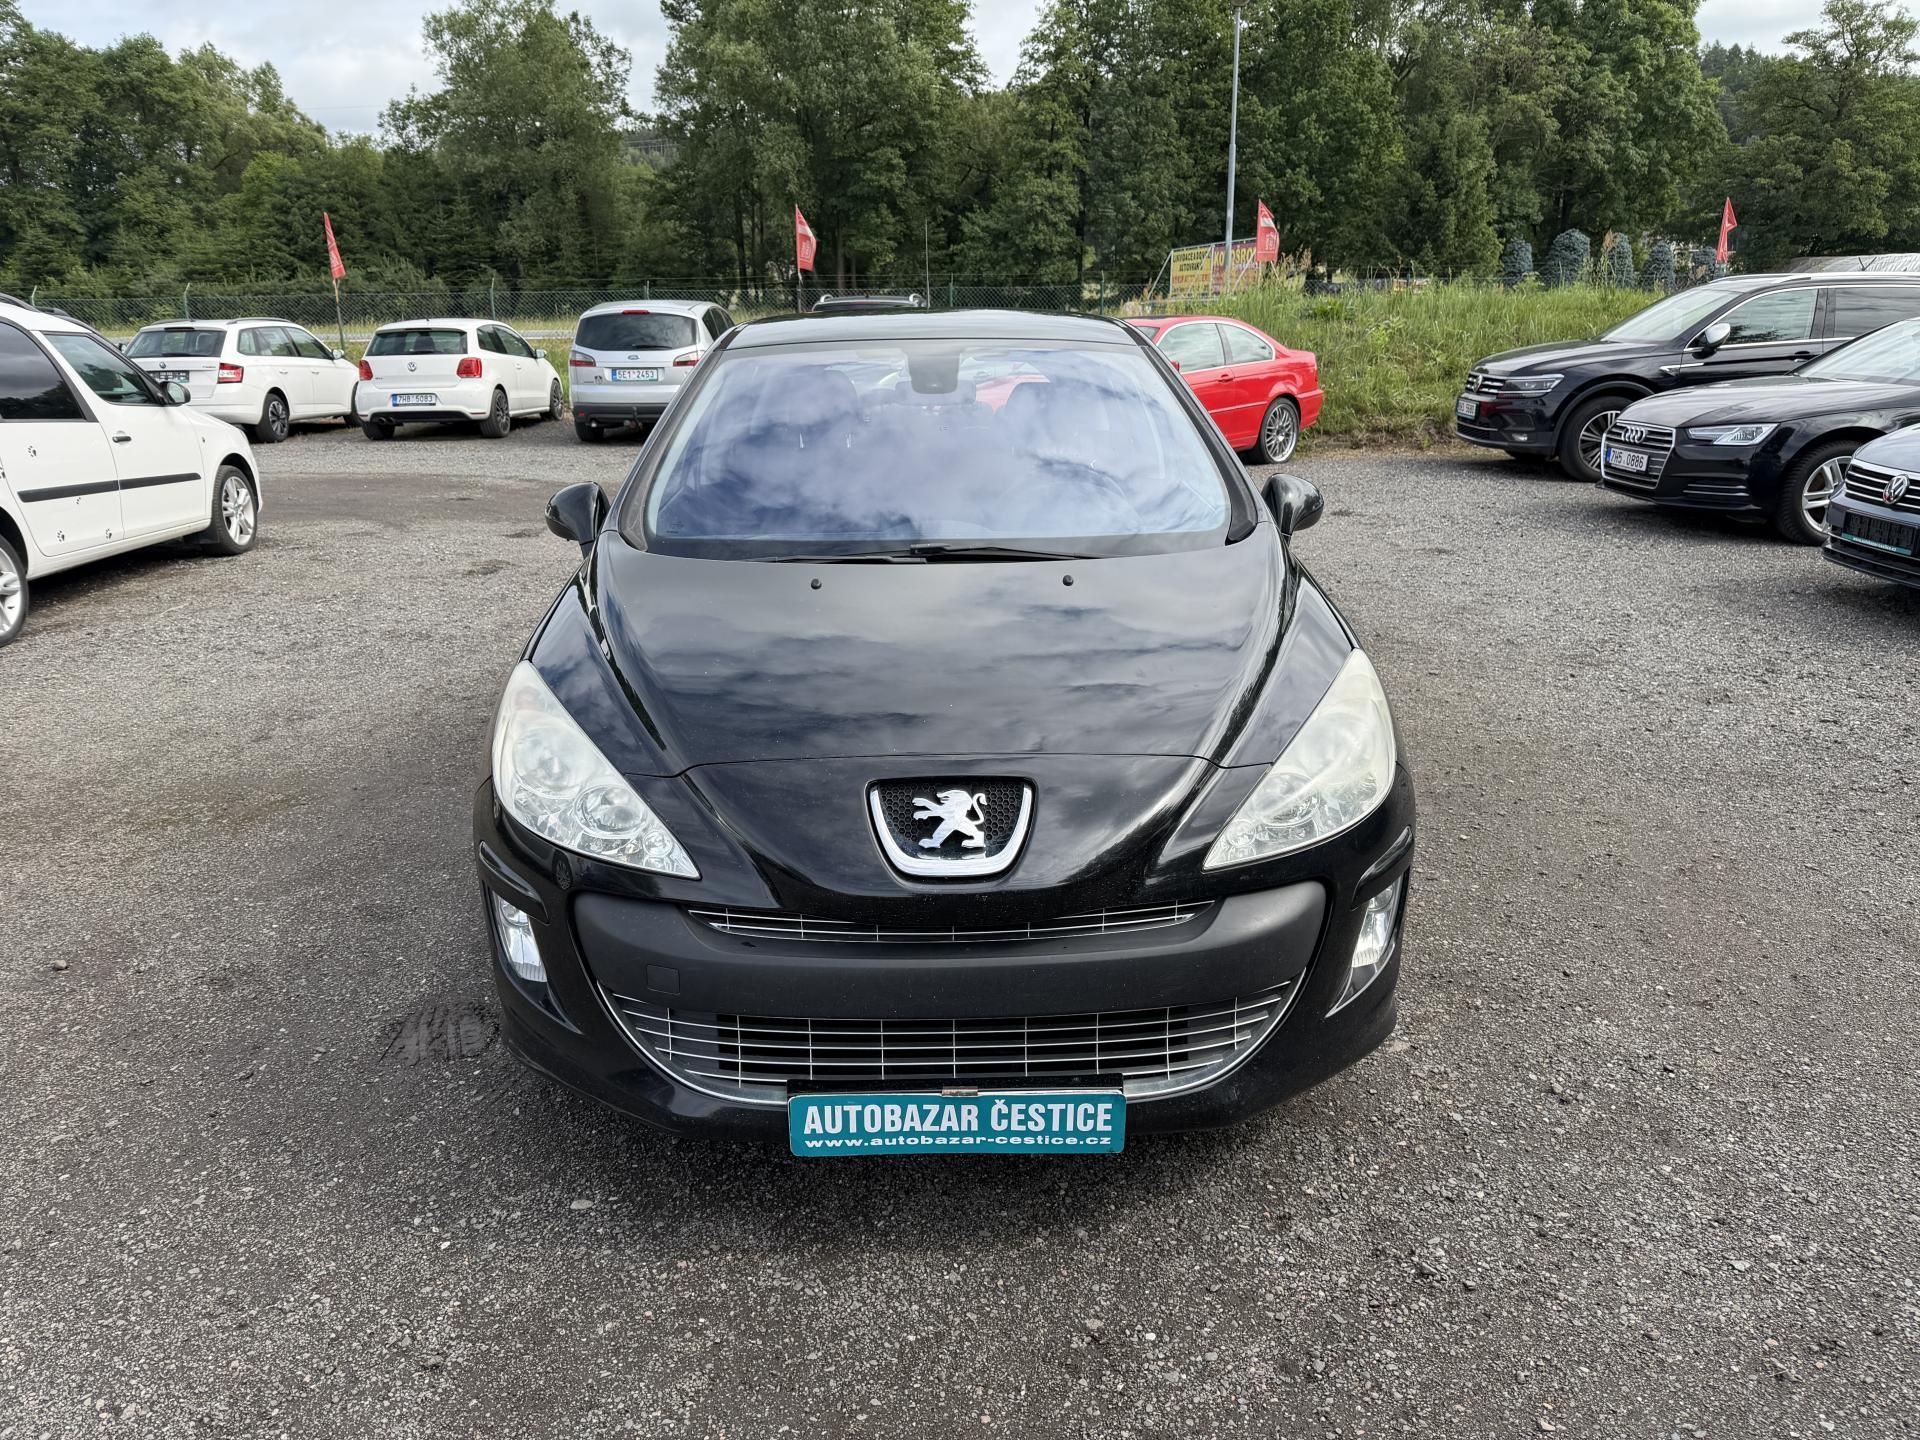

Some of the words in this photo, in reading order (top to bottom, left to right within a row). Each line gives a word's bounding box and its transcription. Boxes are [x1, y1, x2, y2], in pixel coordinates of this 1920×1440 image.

[1213, 245, 1257, 266] KOOŠRO
[636, 370, 655, 379] 2453
[803, 1103, 979, 1134] AUTOBAZAR
[990, 1099, 1113, 1132] ČESTICE
[804, 1135, 1112, 1148] www.autobazar-cestice.cz
